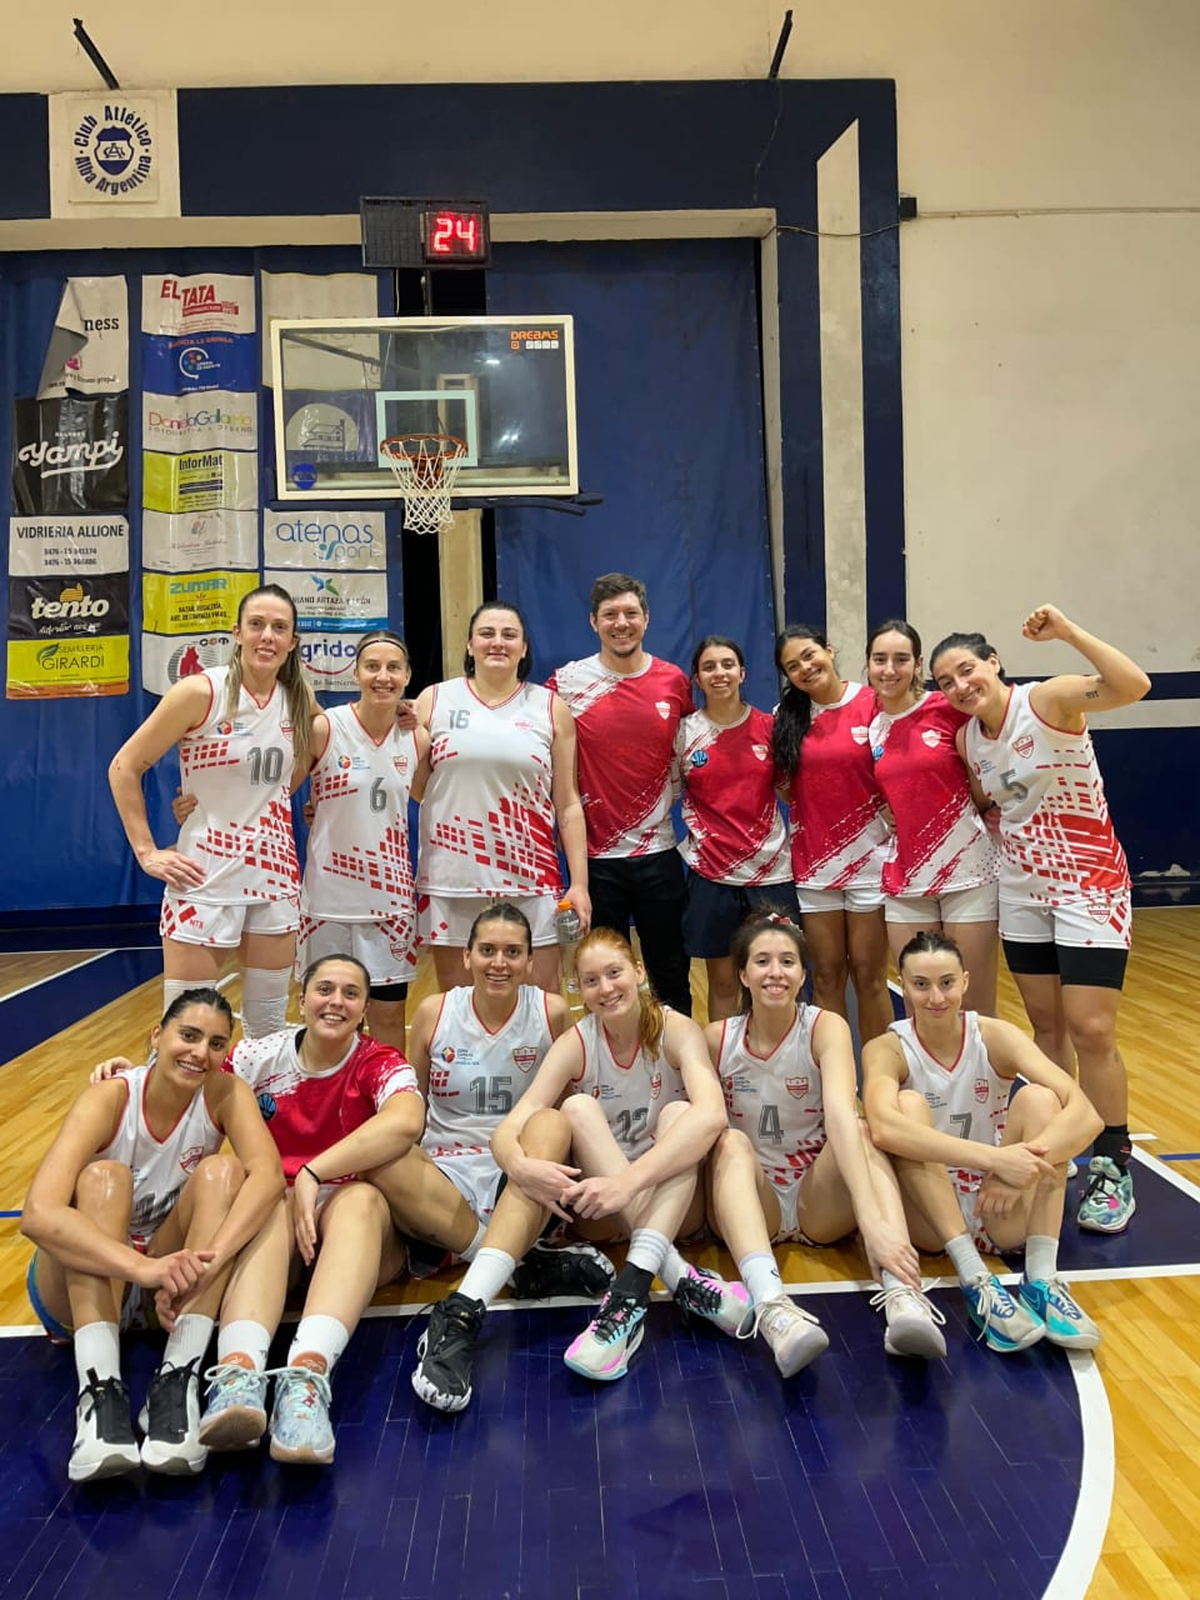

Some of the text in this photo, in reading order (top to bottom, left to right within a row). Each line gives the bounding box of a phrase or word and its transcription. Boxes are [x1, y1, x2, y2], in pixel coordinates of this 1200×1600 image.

[74, 105, 152, 147] Club Atlético
[75, 155, 152, 196] Alba Argentina
[433, 217, 476, 252] 24
[160, 279, 181, 300] EL
[181, 284, 216, 307] TATA
[83, 317, 120, 332] ness
[16, 524, 125, 540] VIDRIERIA ALLIONE
[276, 519, 374, 544] atenas
[31, 595, 110, 620] tento
[41, 655, 105, 671] GIRARDI
[300, 639, 357, 663] grido
[449, 709, 470, 730] 16
[247, 746, 284, 786] 10
[370, 776, 387, 813] 6
[1000, 768, 1029, 802] 5
[469, 1075, 513, 1115] 15
[758, 1104, 785, 1146] 4
[949, 1112, 973, 1140] 7
